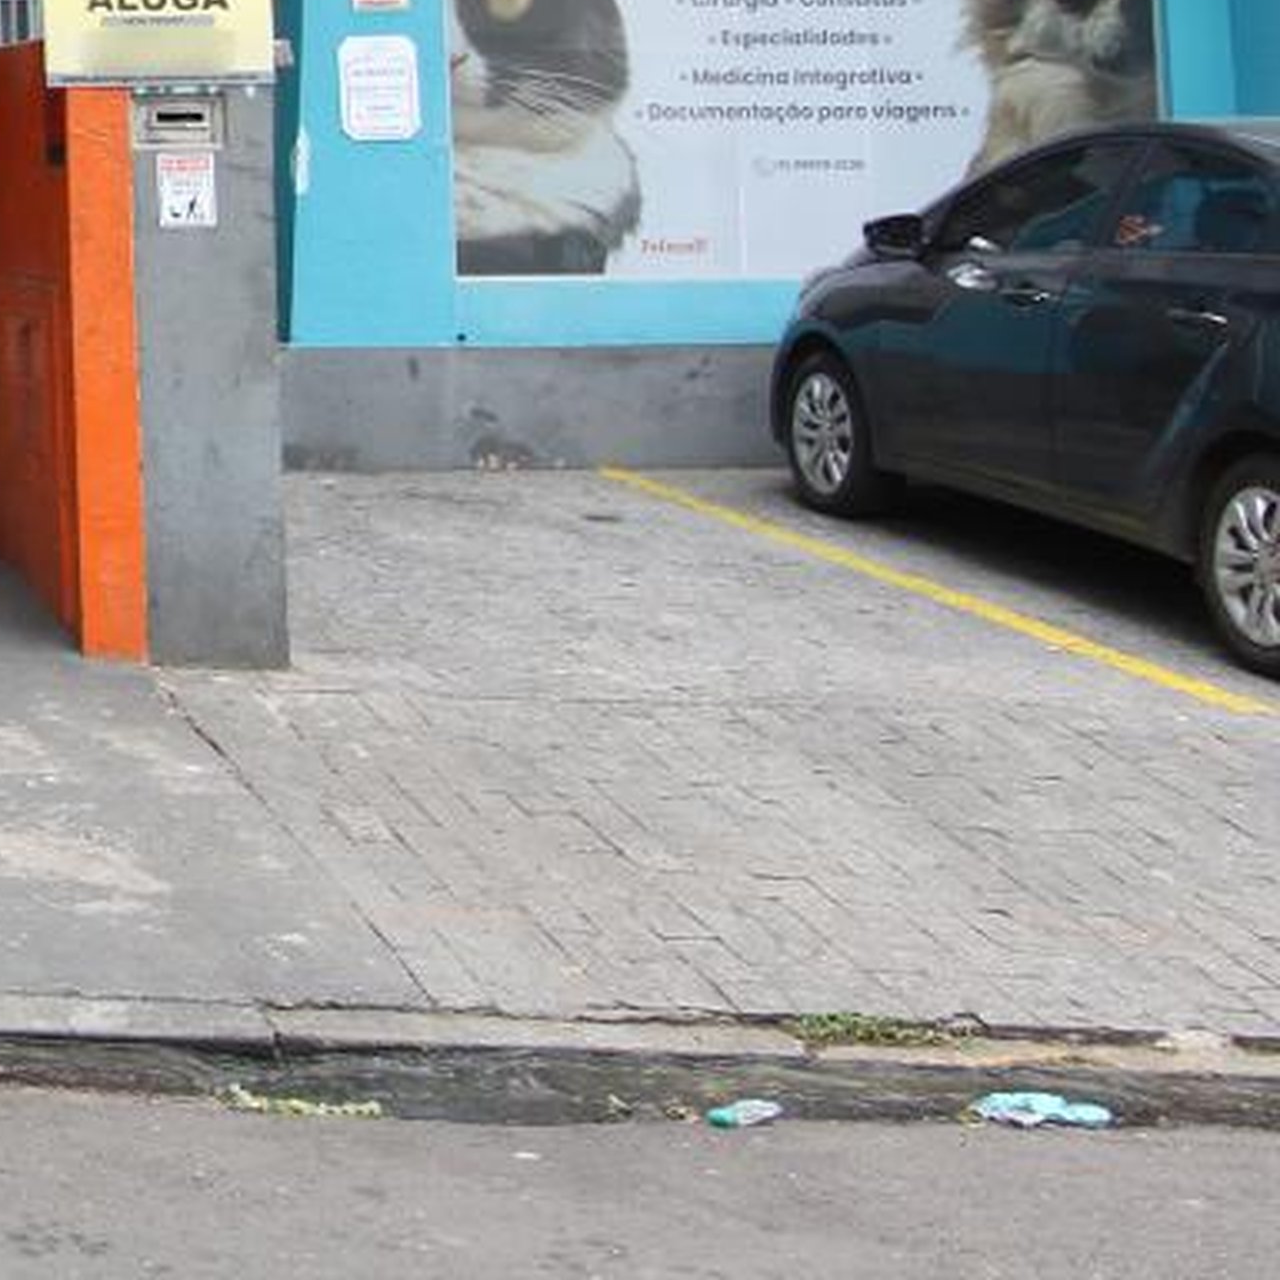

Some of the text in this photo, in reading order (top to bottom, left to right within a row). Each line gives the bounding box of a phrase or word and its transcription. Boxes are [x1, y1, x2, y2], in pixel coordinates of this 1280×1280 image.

[720, 28, 880, 49] Especialidades
[692, 68, 912, 91] Medicina Integrativa
[648, 99, 958, 124] Documentação para viagens
